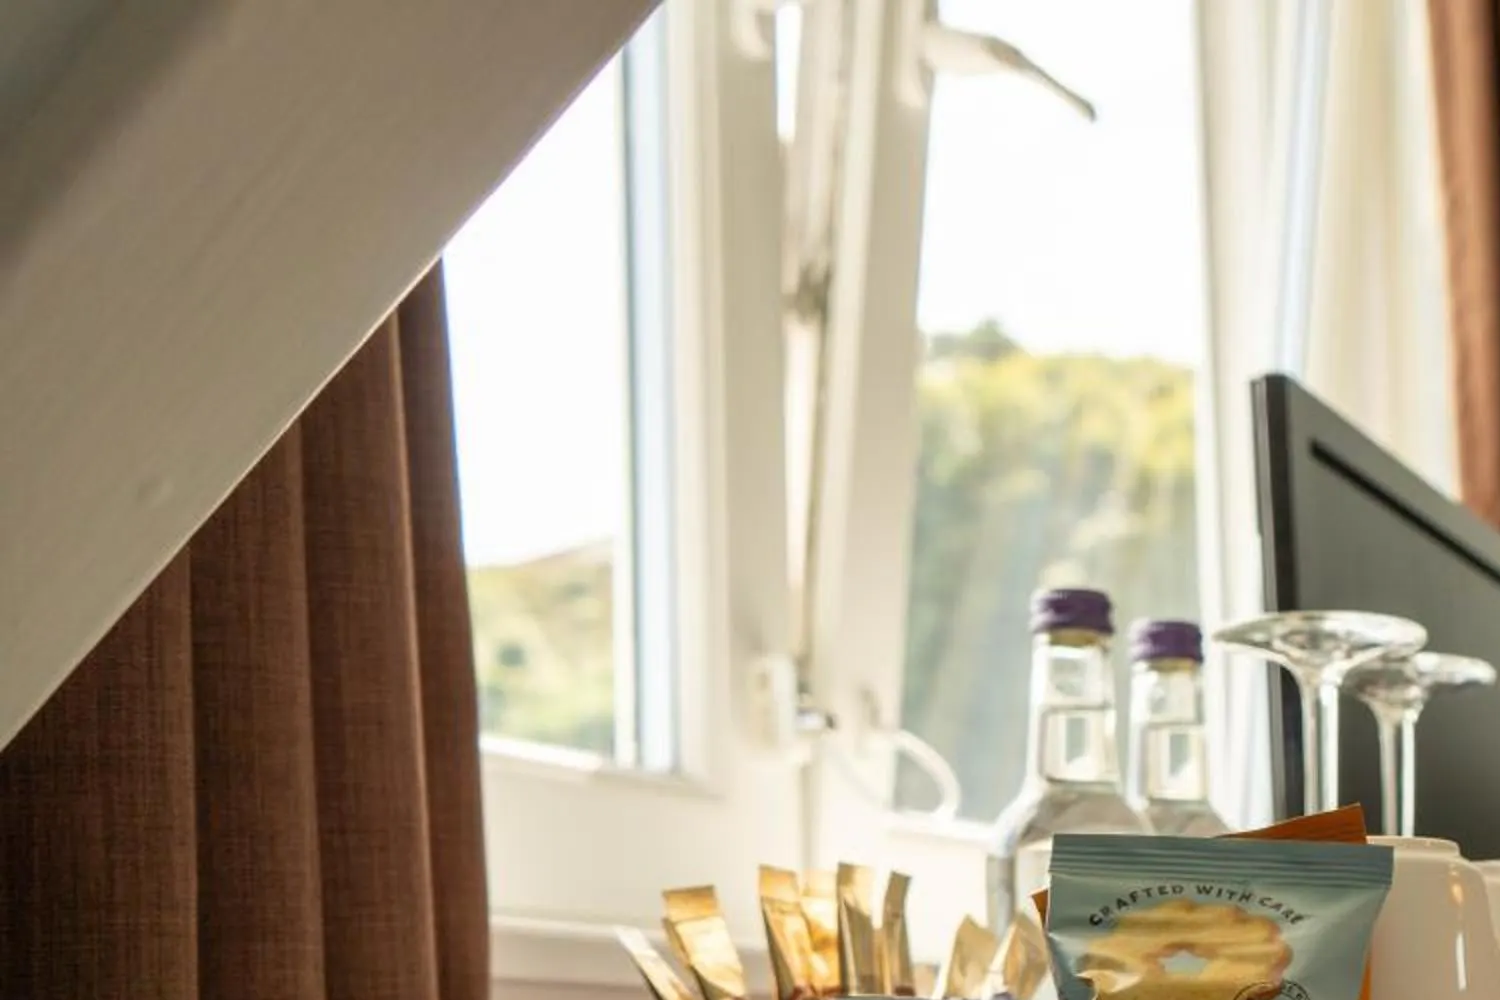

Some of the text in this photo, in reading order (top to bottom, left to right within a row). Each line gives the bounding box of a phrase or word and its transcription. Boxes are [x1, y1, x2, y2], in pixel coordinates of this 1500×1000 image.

[1089, 885, 1304, 926] CRAFTED WITH CARE
